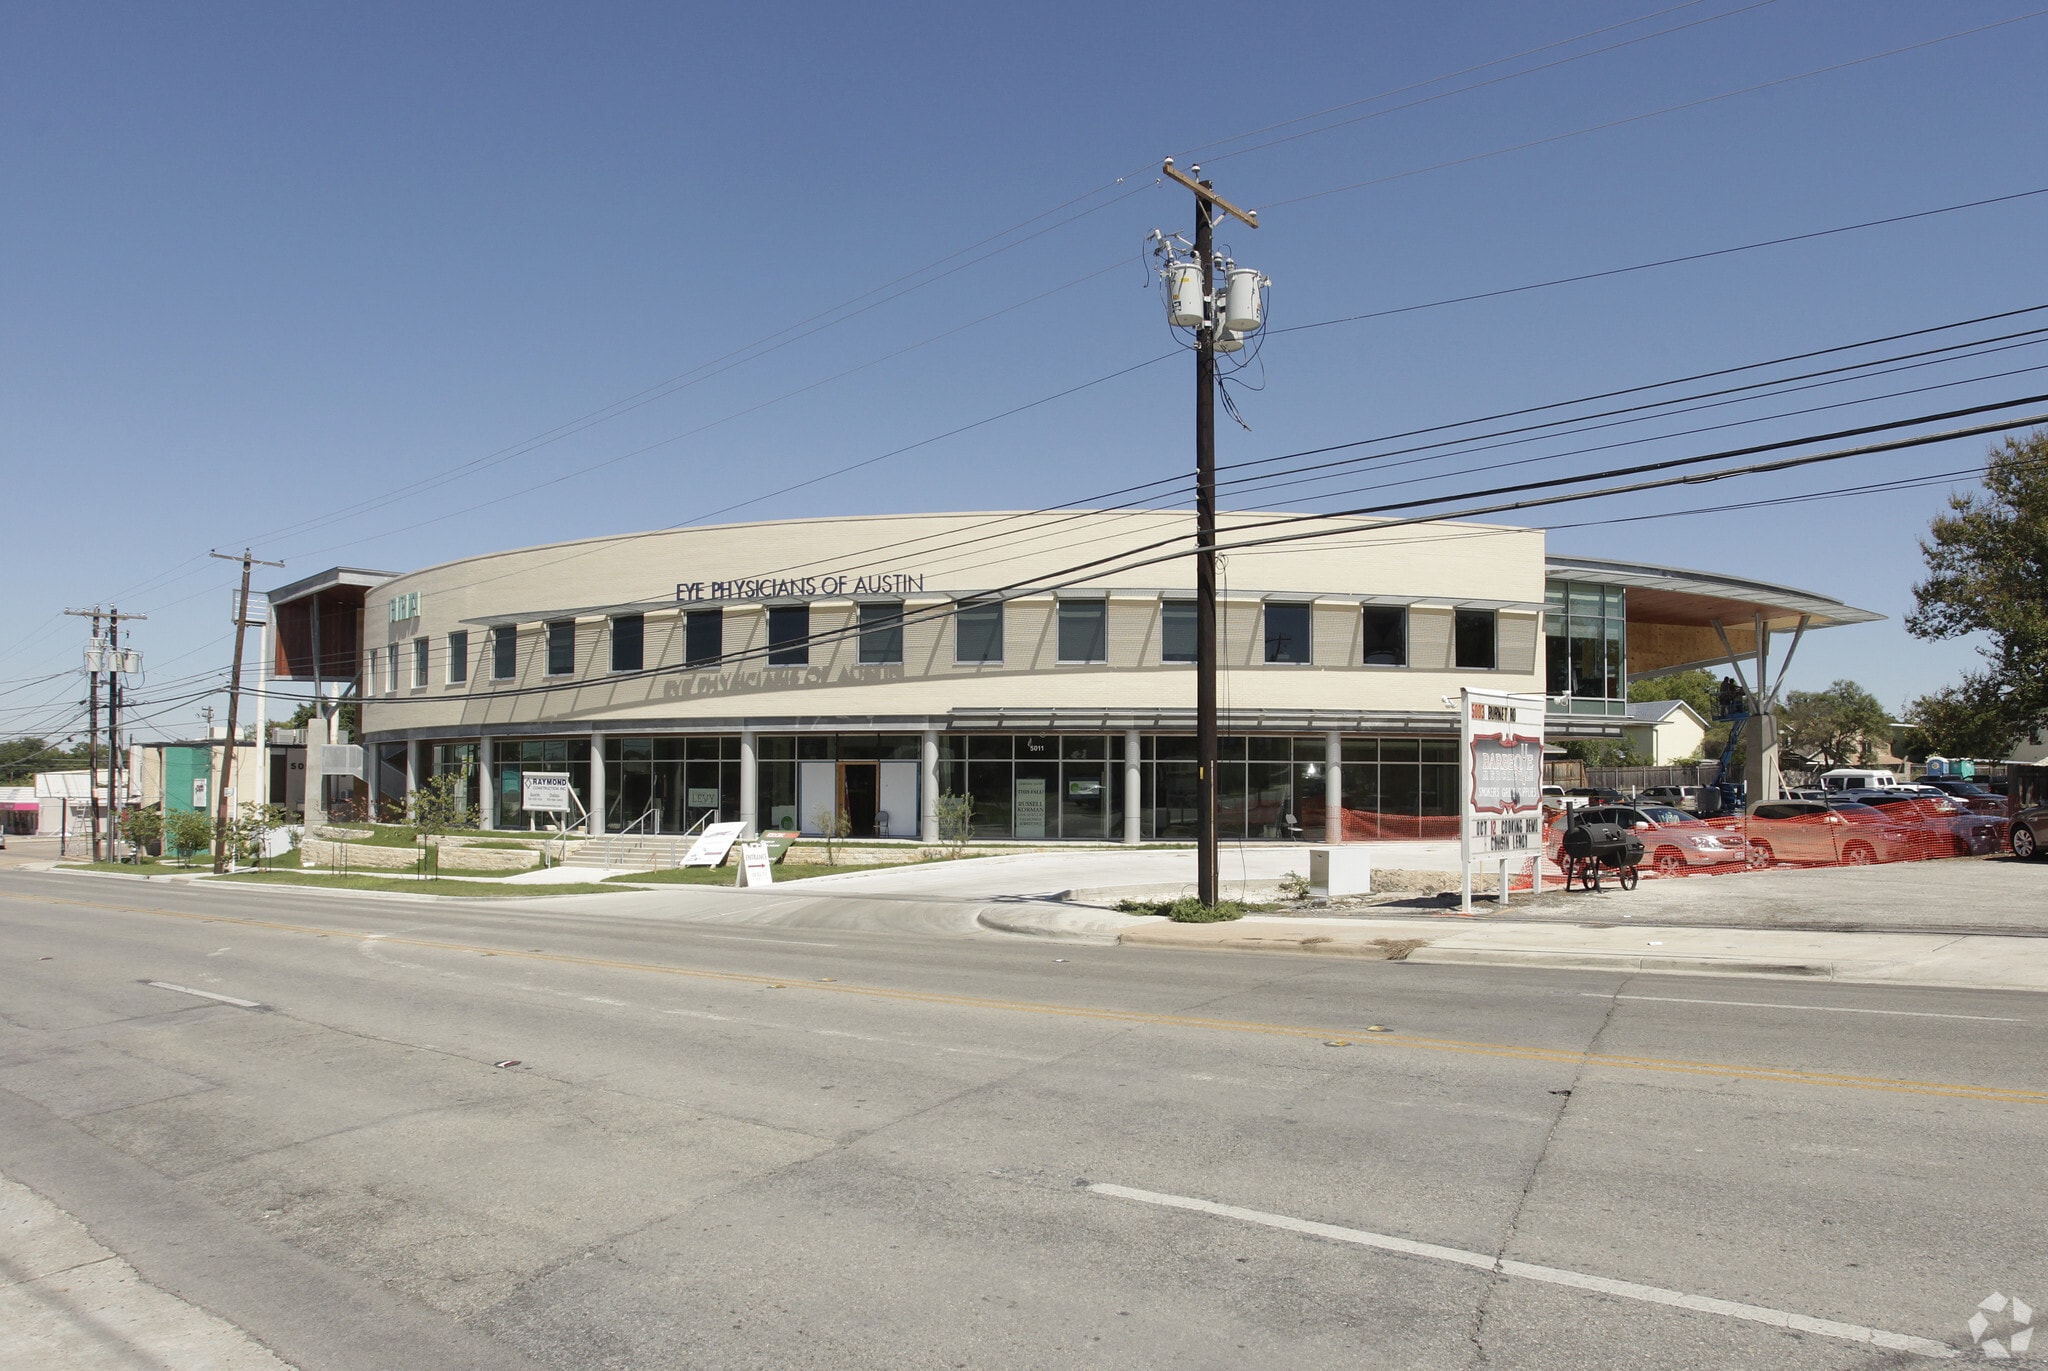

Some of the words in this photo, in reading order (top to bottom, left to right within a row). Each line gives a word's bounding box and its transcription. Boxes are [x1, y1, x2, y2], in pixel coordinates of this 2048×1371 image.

[676, 582, 704, 601] EYE
[712, 577, 816, 600] PHYSICIANS
[821, 575, 848, 596] OF
[853, 573, 924, 594] AUSTIN
[533, 778, 567, 786] RAYMOND
[1478, 786, 1500, 797] SMOKERS
[692, 794, 715, 803] LEVY
[1477, 821, 1487, 836] OCT
[1490, 820, 1496, 835] 12
[1501, 819, 1522, 834] COOKING
[1526, 818, 1538, 833] DEMO
